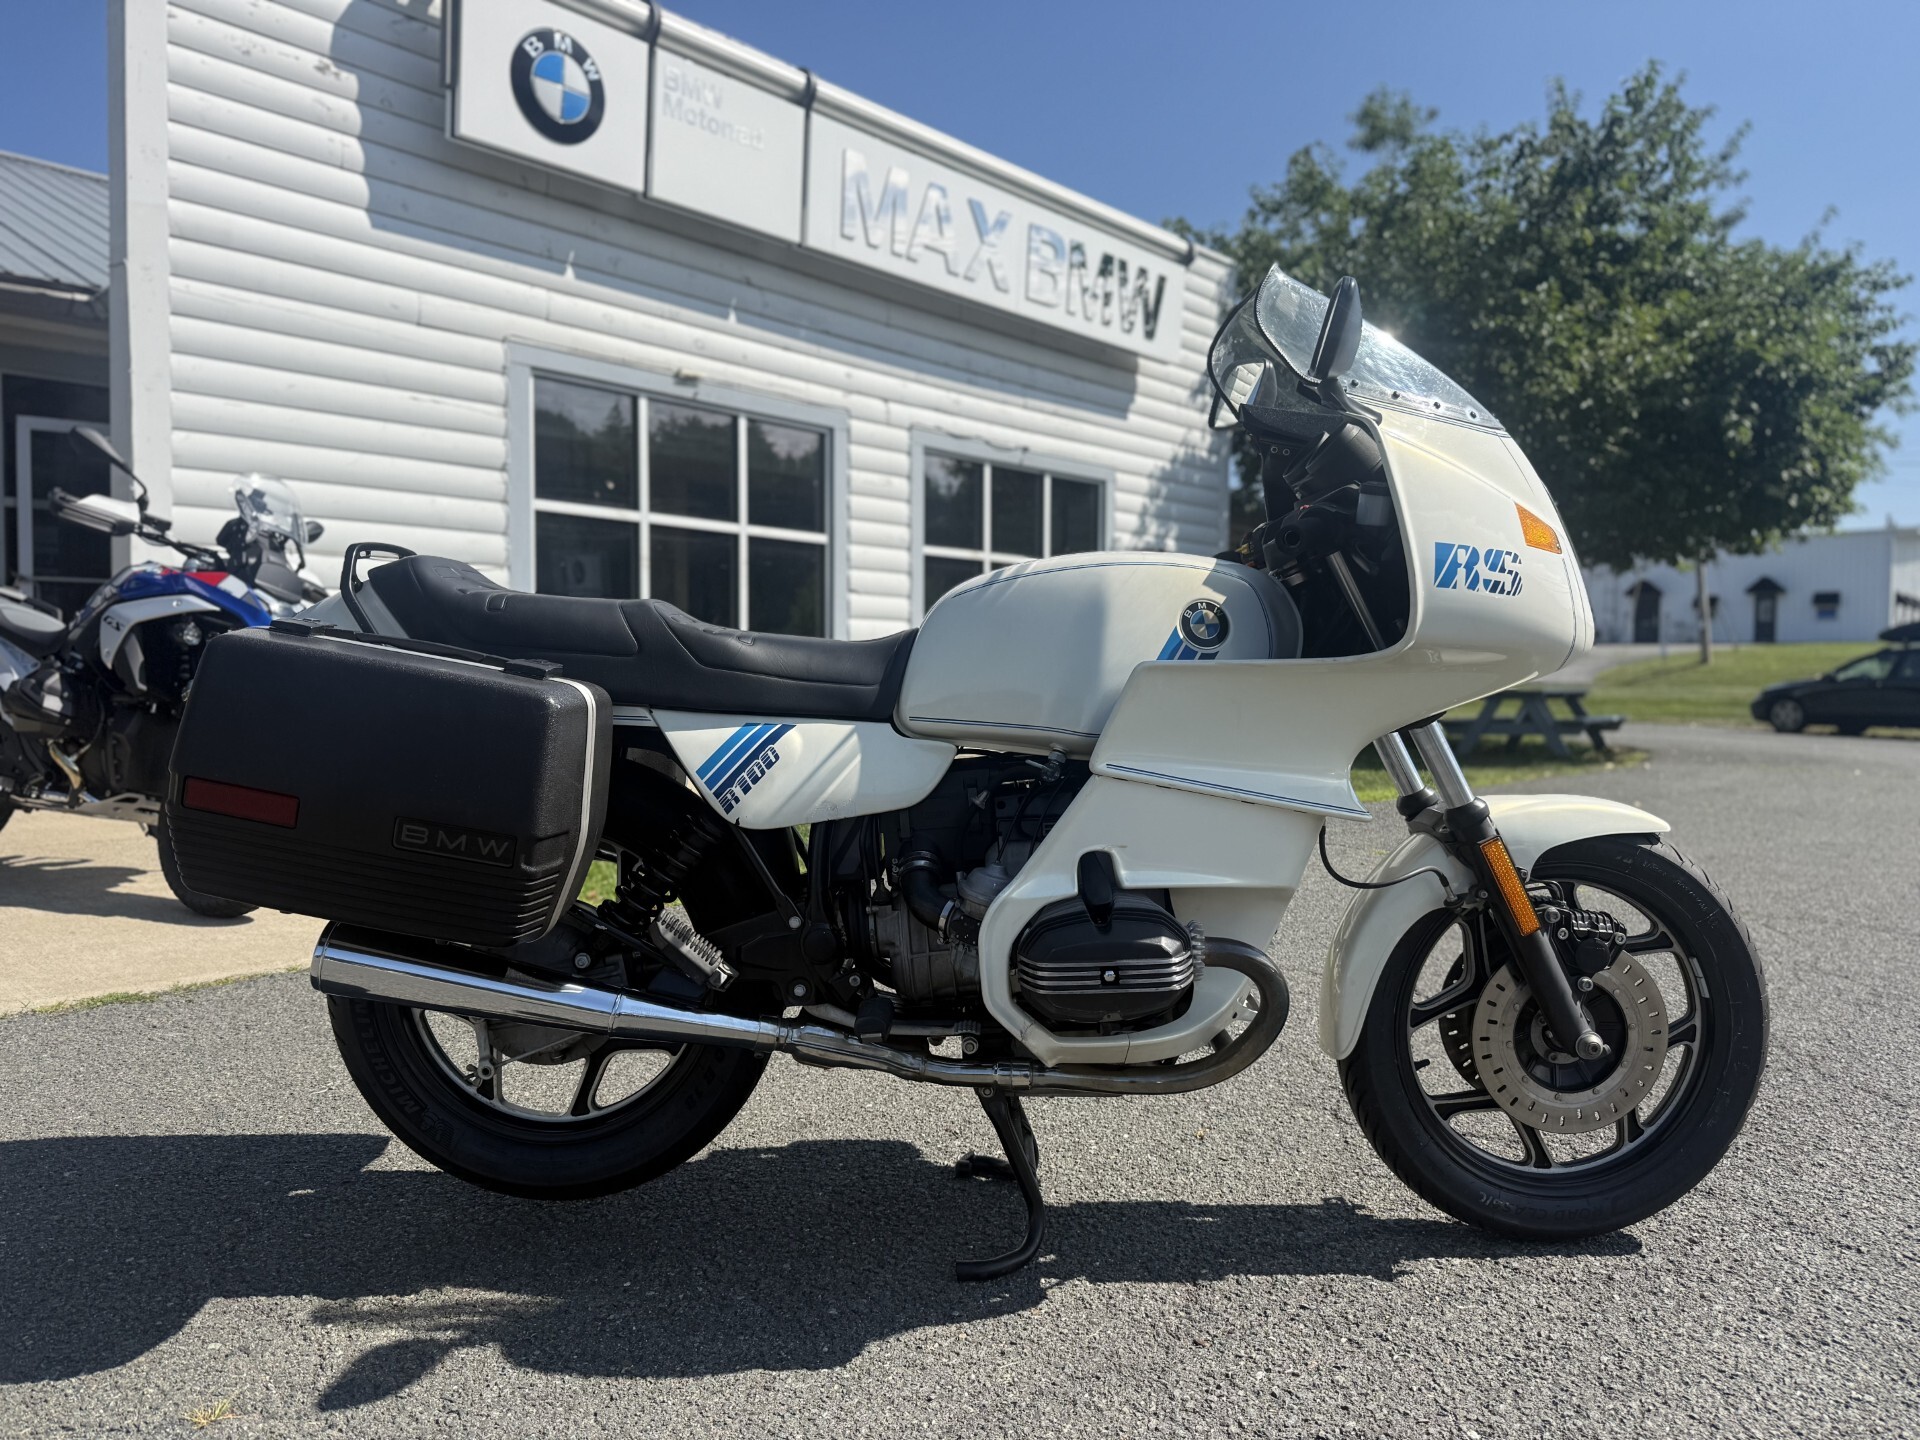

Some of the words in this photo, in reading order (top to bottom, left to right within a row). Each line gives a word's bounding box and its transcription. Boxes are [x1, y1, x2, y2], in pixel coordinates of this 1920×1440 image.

[522, 31, 600, 82] BMW
[664, 65, 723, 110] BMW
[662, 93, 765, 150] Motorrad
[840, 148, 1010, 294] MAX
[1024, 222, 1166, 341] BMW
[1434, 542, 1523, 597] RS
[1184, 602, 1223, 618] BMW
[718, 744, 780, 815] R100
[402, 824, 509, 858] BMW
